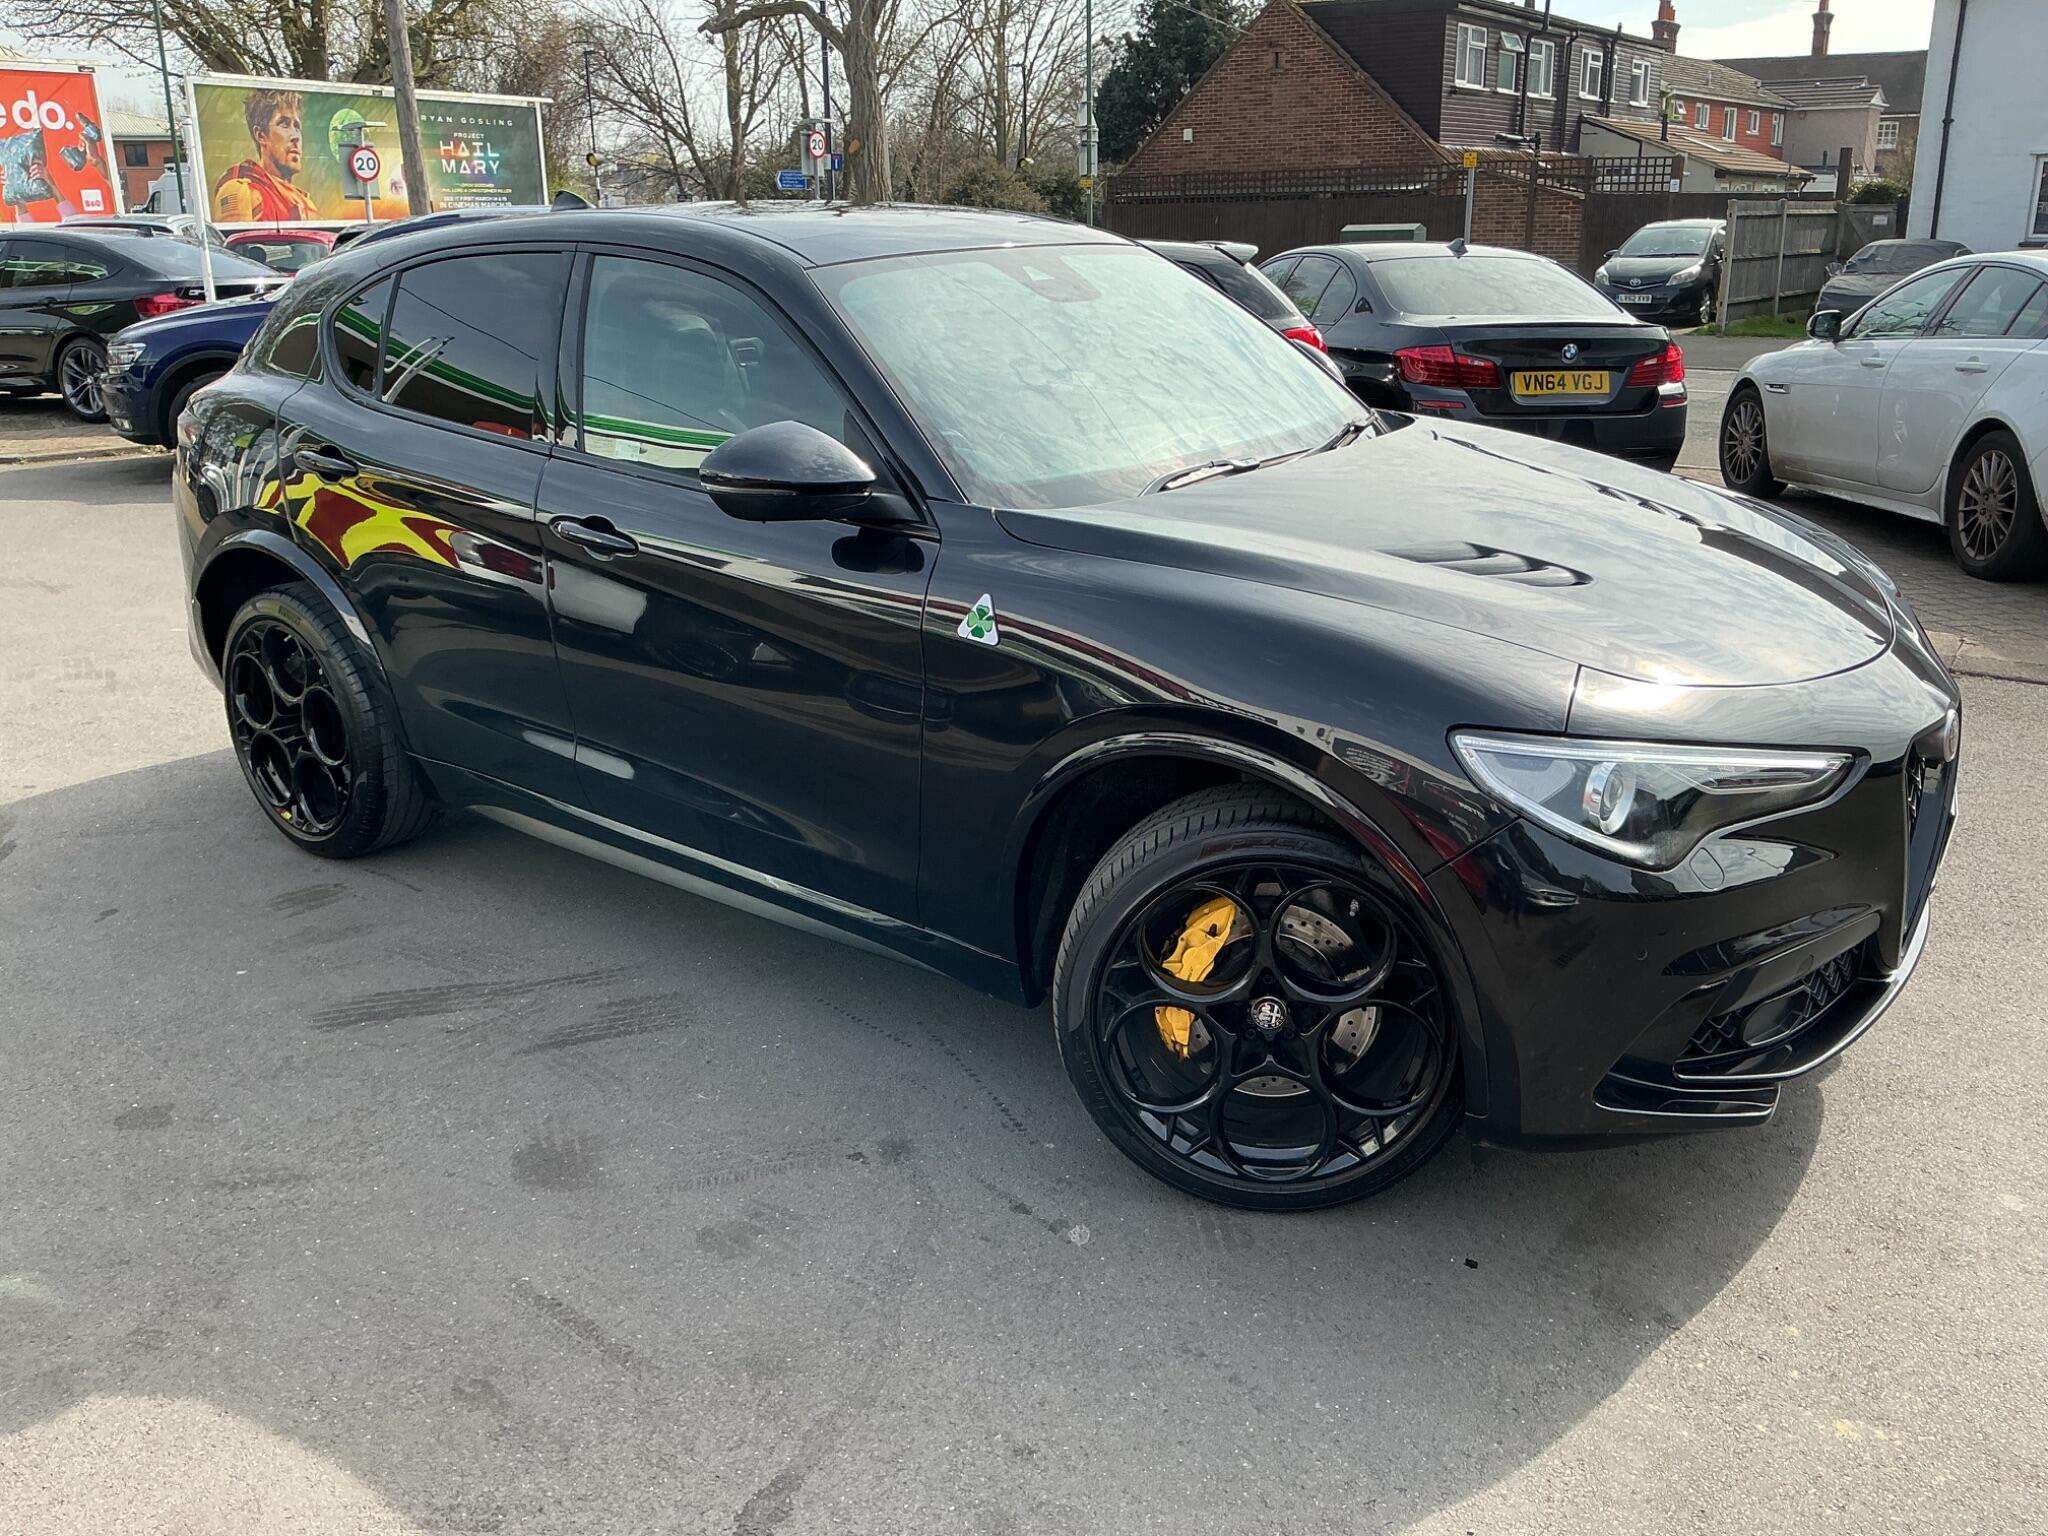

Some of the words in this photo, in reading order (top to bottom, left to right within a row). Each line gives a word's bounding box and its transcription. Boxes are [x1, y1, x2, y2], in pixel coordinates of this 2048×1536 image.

[12, 89, 75, 131] do.
[420, 114, 453, 123] RYAN
[460, 117, 513, 127] GOSLING
[440, 140, 500, 157] HAIL
[811, 139, 824, 151] 20
[355, 156, 377, 171] 20
[441, 158, 500, 174] MARY
[1523, 374, 1566, 391] VN64
[1572, 373, 1603, 390] VGJ
